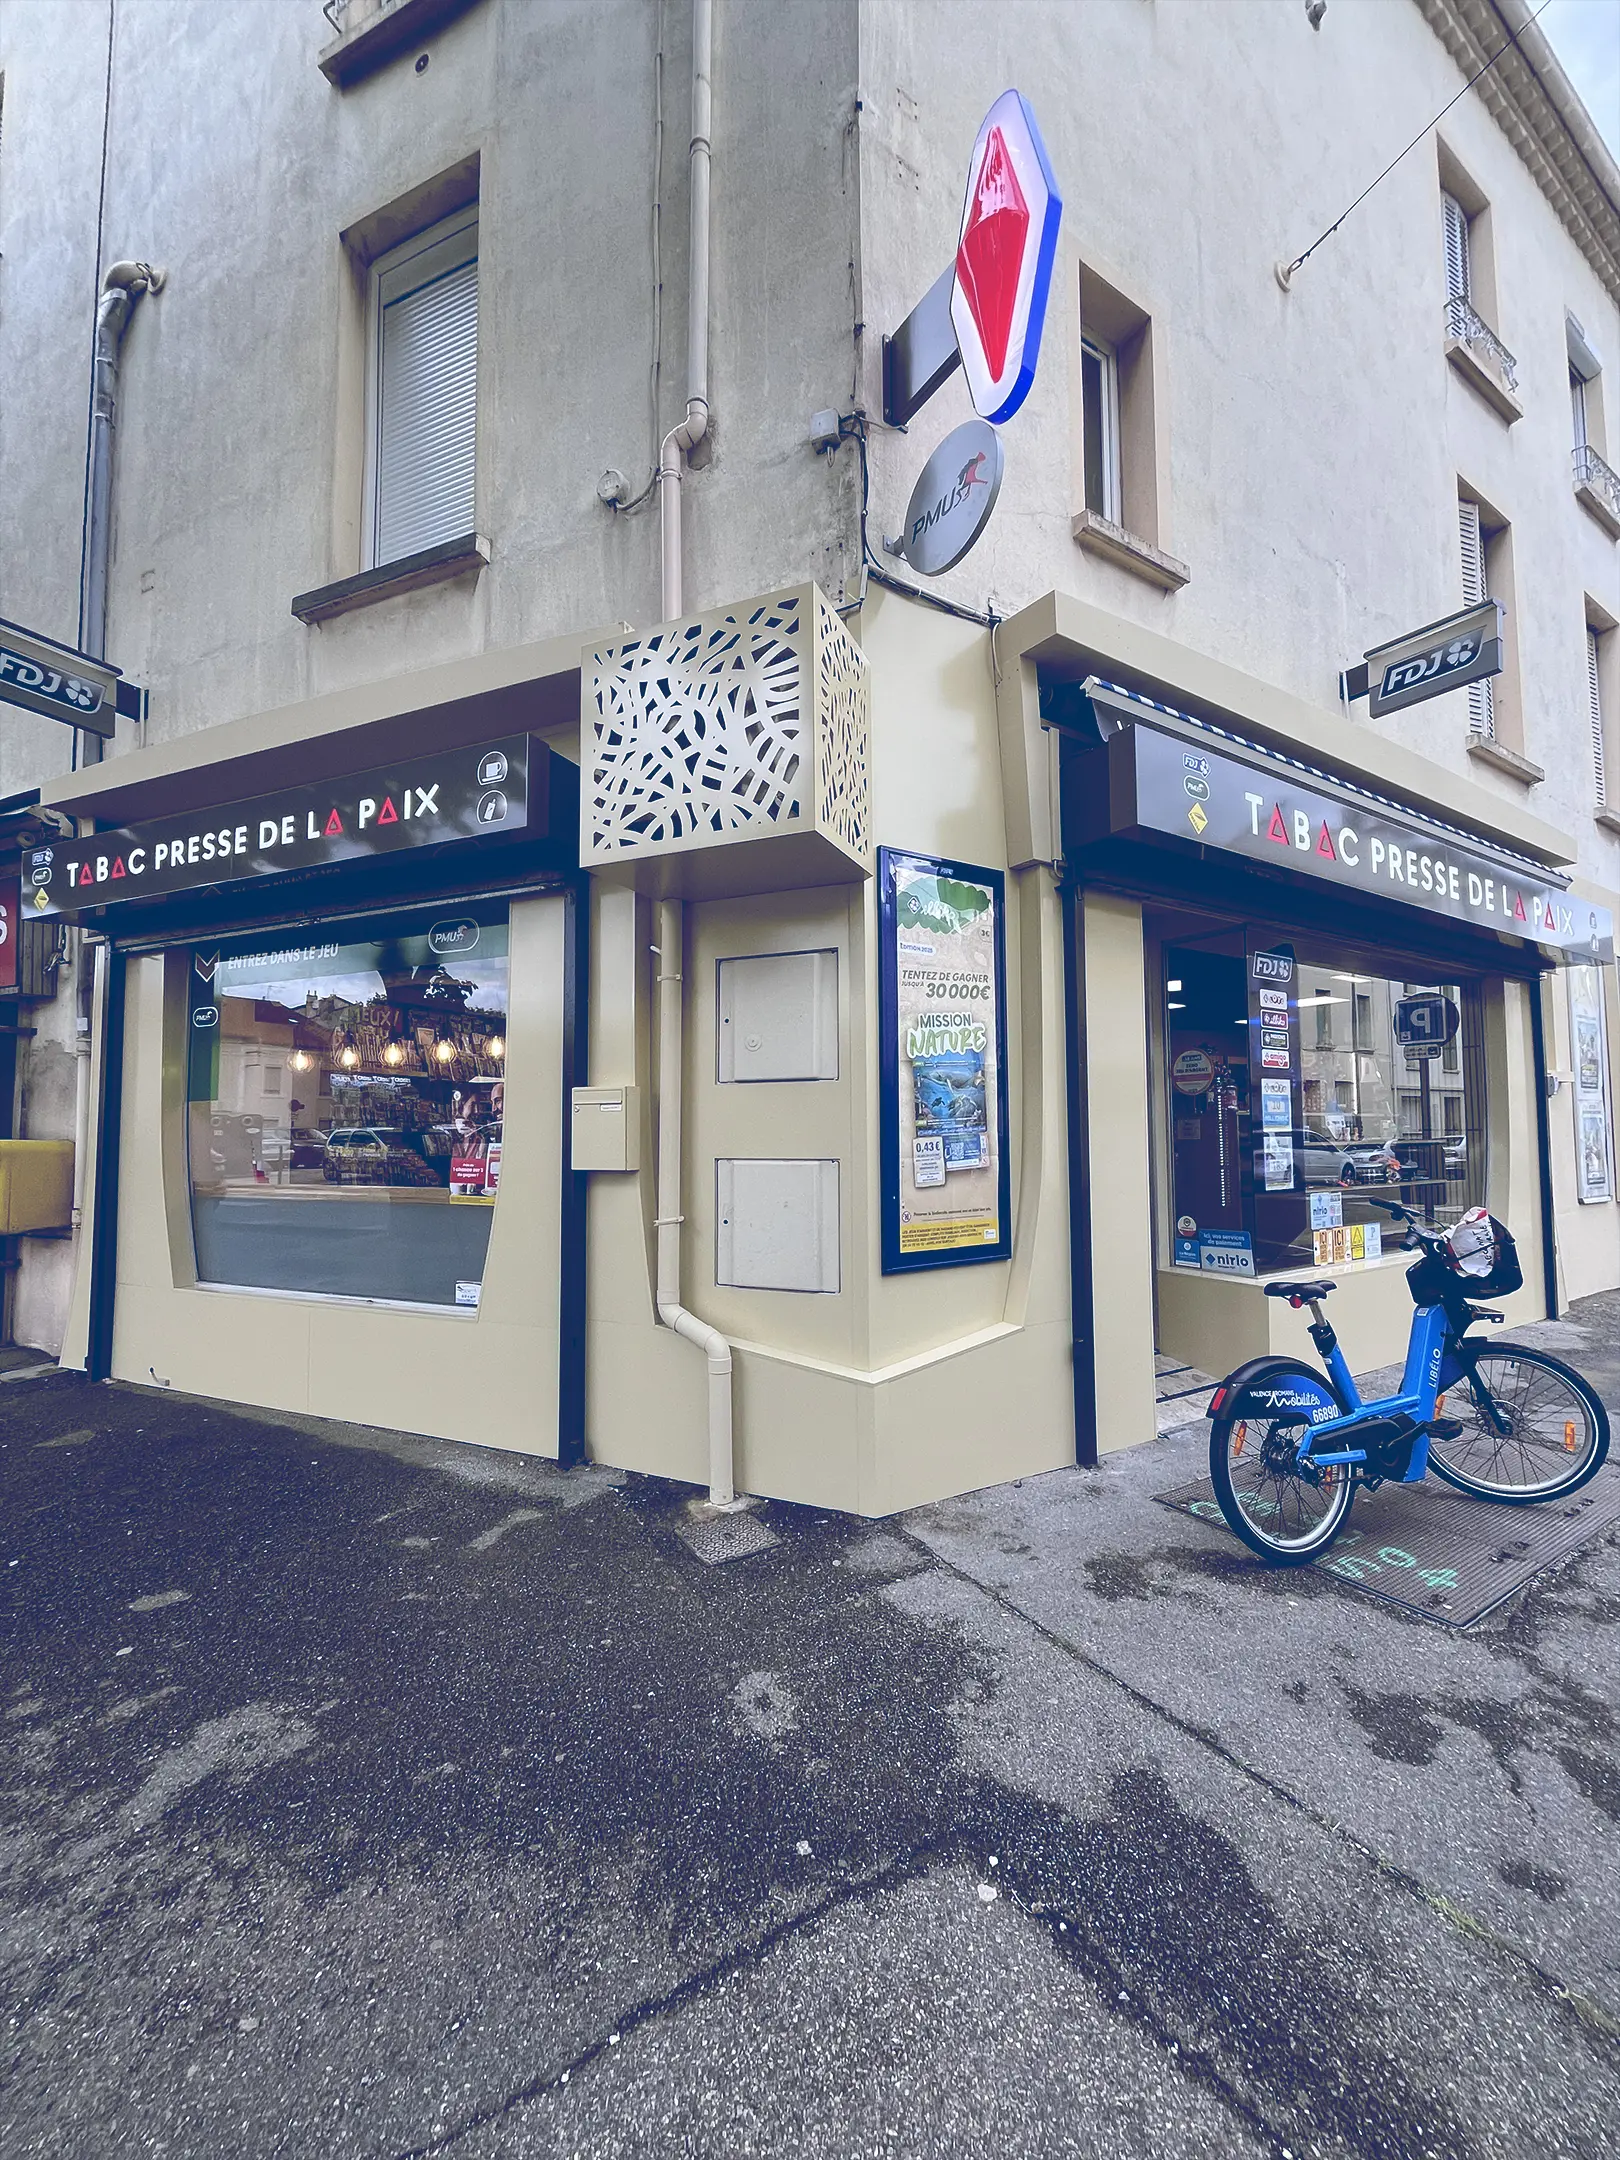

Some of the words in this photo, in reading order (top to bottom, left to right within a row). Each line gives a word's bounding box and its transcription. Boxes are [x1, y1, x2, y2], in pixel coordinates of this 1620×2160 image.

[912, 486, 956, 545] PMU
[0, 653, 62, 692] FDJ
[1386, 654, 1443, 693] FDJ
[1185, 757, 1199, 769] FDJ
[66, 848, 146, 888] TABAC
[154, 826, 247, 870] PRESSE
[259, 815, 295, 850] DE
[307, 808, 344, 839] LA
[359, 784, 439, 827] PAIX
[1245, 792, 1359, 867] TABAC
[1371, 837, 1460, 901] PRESSE
[1469, 873, 1495, 912] DE
[1502, 891, 1526, 921] LA
[1533, 902, 1575, 936] PAIX
[435, 931, 457, 944] PMU
[227, 954, 268, 970] ENTREZ
[270, 949, 301, 965] DANS
[303, 947, 316, 961] LE
[317, 943, 339, 960] JEU
[1256, 957, 1278, 976] FDJ
[902, 970, 937, 980] TENTEZ
[938, 972, 951, 981] DE
[952, 972, 989, 983] GAGNER
[926, 983, 947, 999] 30
[919, 1013, 972, 1029] MISSION
[909, 1026, 985, 1057] NATURE
[1217, 1253, 1249, 1267] nirio
[1249, 1390, 1272, 1398] VALENCE
[1312, 1403, 1339, 1423] 66890
